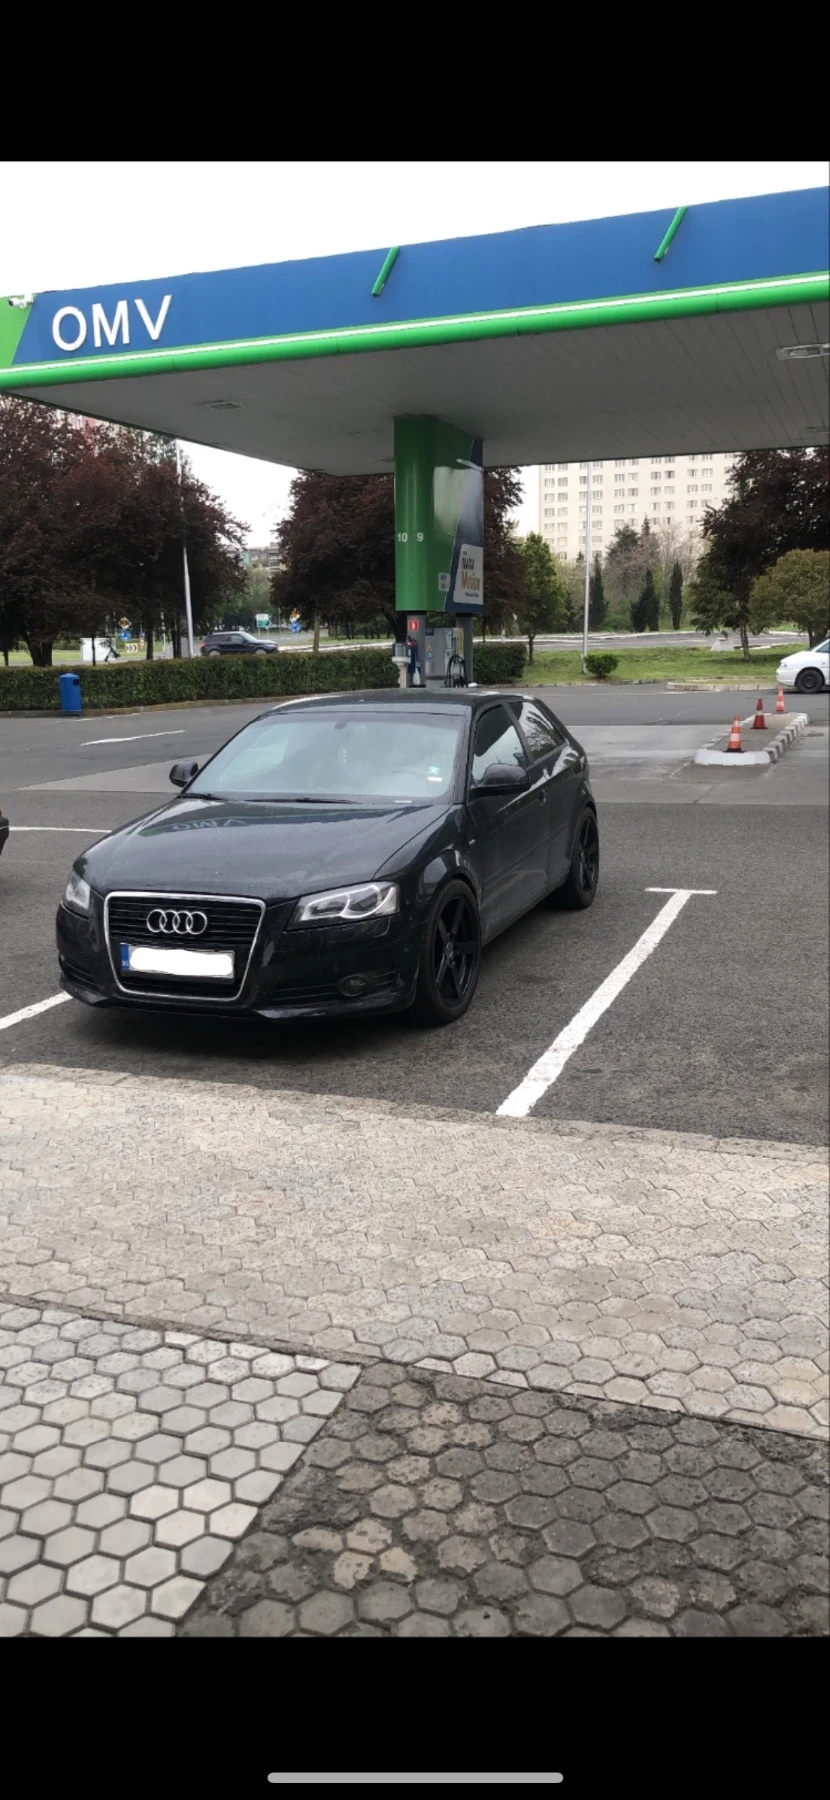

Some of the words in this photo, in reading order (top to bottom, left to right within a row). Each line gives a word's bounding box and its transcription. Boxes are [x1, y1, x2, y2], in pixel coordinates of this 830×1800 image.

[52, 295, 172, 352] OMV
[397, 532, 408, 543] 10
[416, 532, 424, 543] 9
